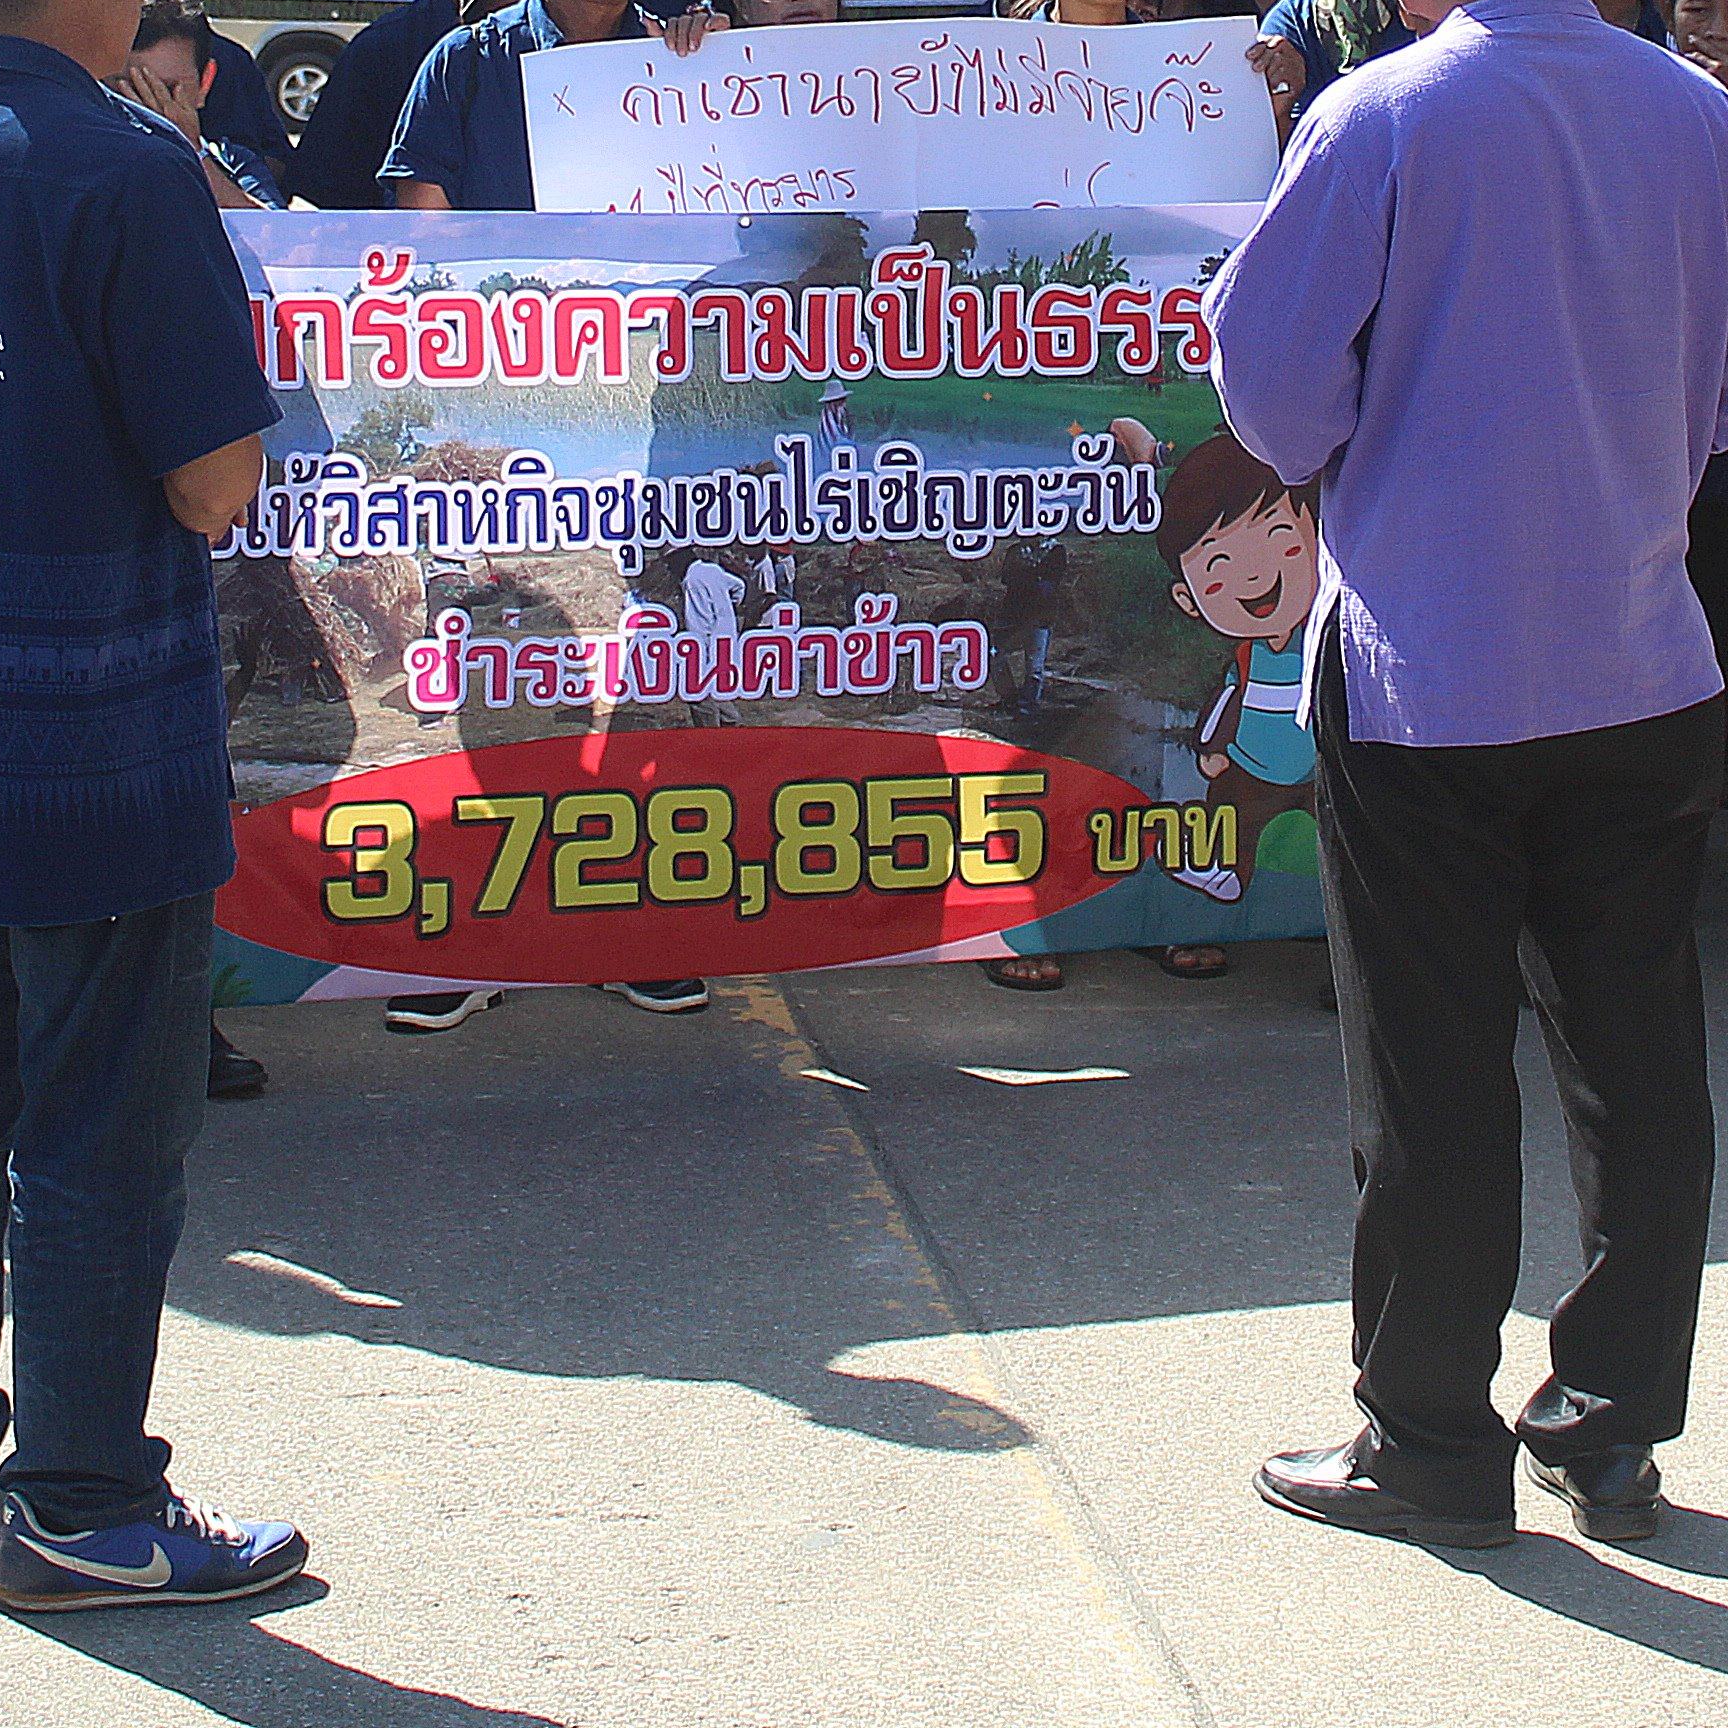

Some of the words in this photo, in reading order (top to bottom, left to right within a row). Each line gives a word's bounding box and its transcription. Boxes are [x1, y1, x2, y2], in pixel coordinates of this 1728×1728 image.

[410, 600, 984, 706] ชำระเงินค่าข้าว
[325, 774, 1047, 934] 3,728,855
[1090, 804, 1239, 873] บาท
